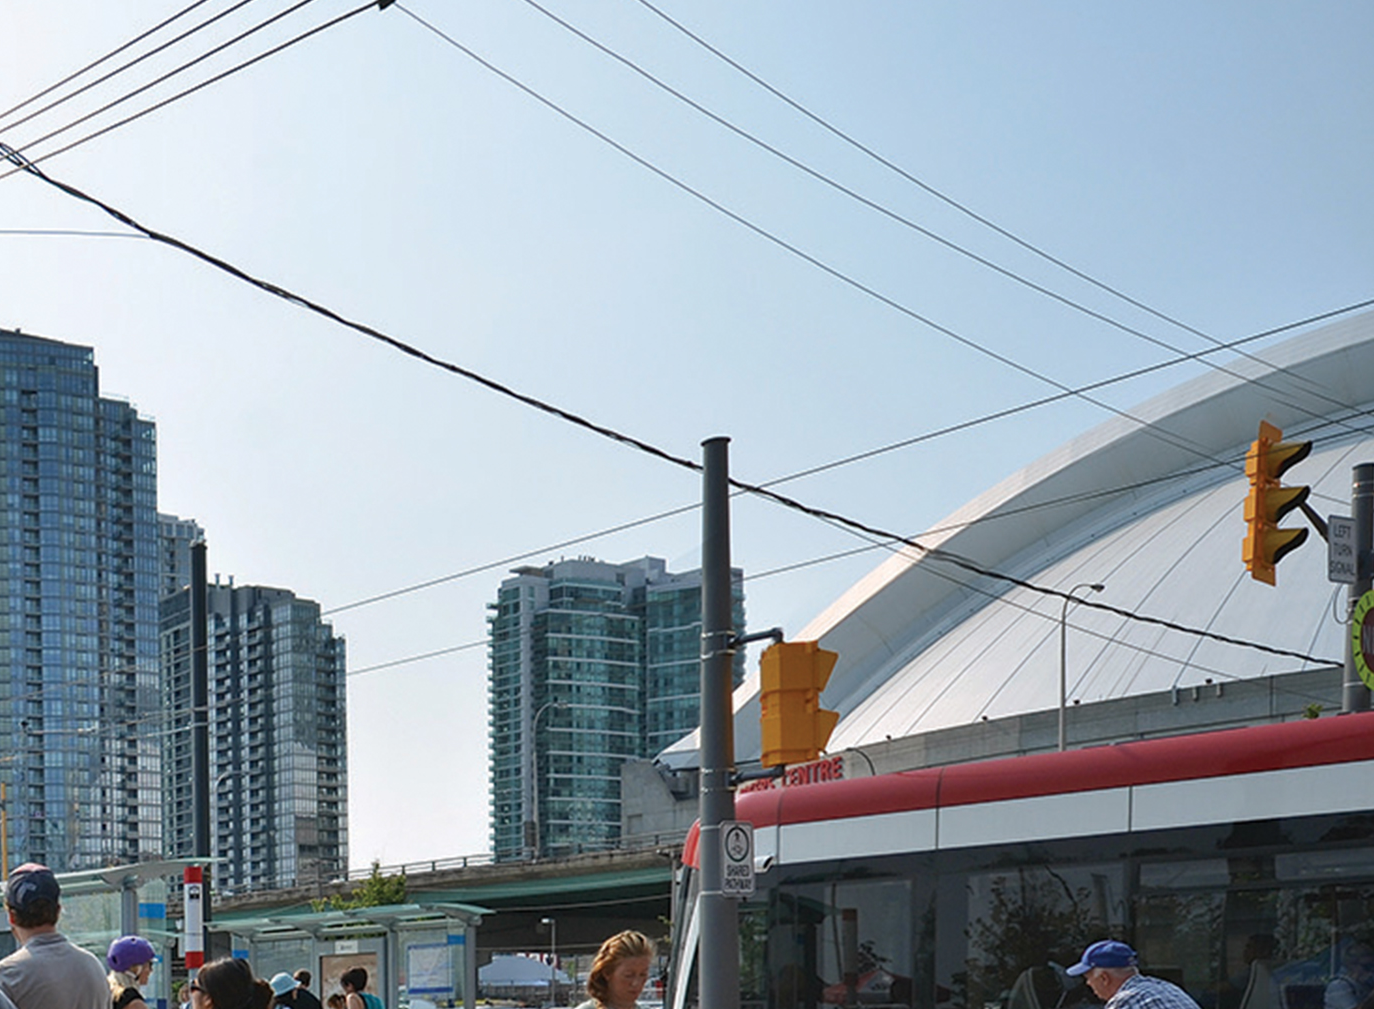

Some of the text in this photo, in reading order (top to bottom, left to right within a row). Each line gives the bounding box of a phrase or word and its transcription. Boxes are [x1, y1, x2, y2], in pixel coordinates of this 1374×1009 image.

[1333, 524, 1351, 539] LEFT
[1334, 542, 1352, 556] TURN
[1330, 560, 1355, 575] SIGNAL
[782, 756, 843, 788] CENTRE
[727, 864, 749, 877] SHARED
[725, 878, 752, 890] PATHWAY
